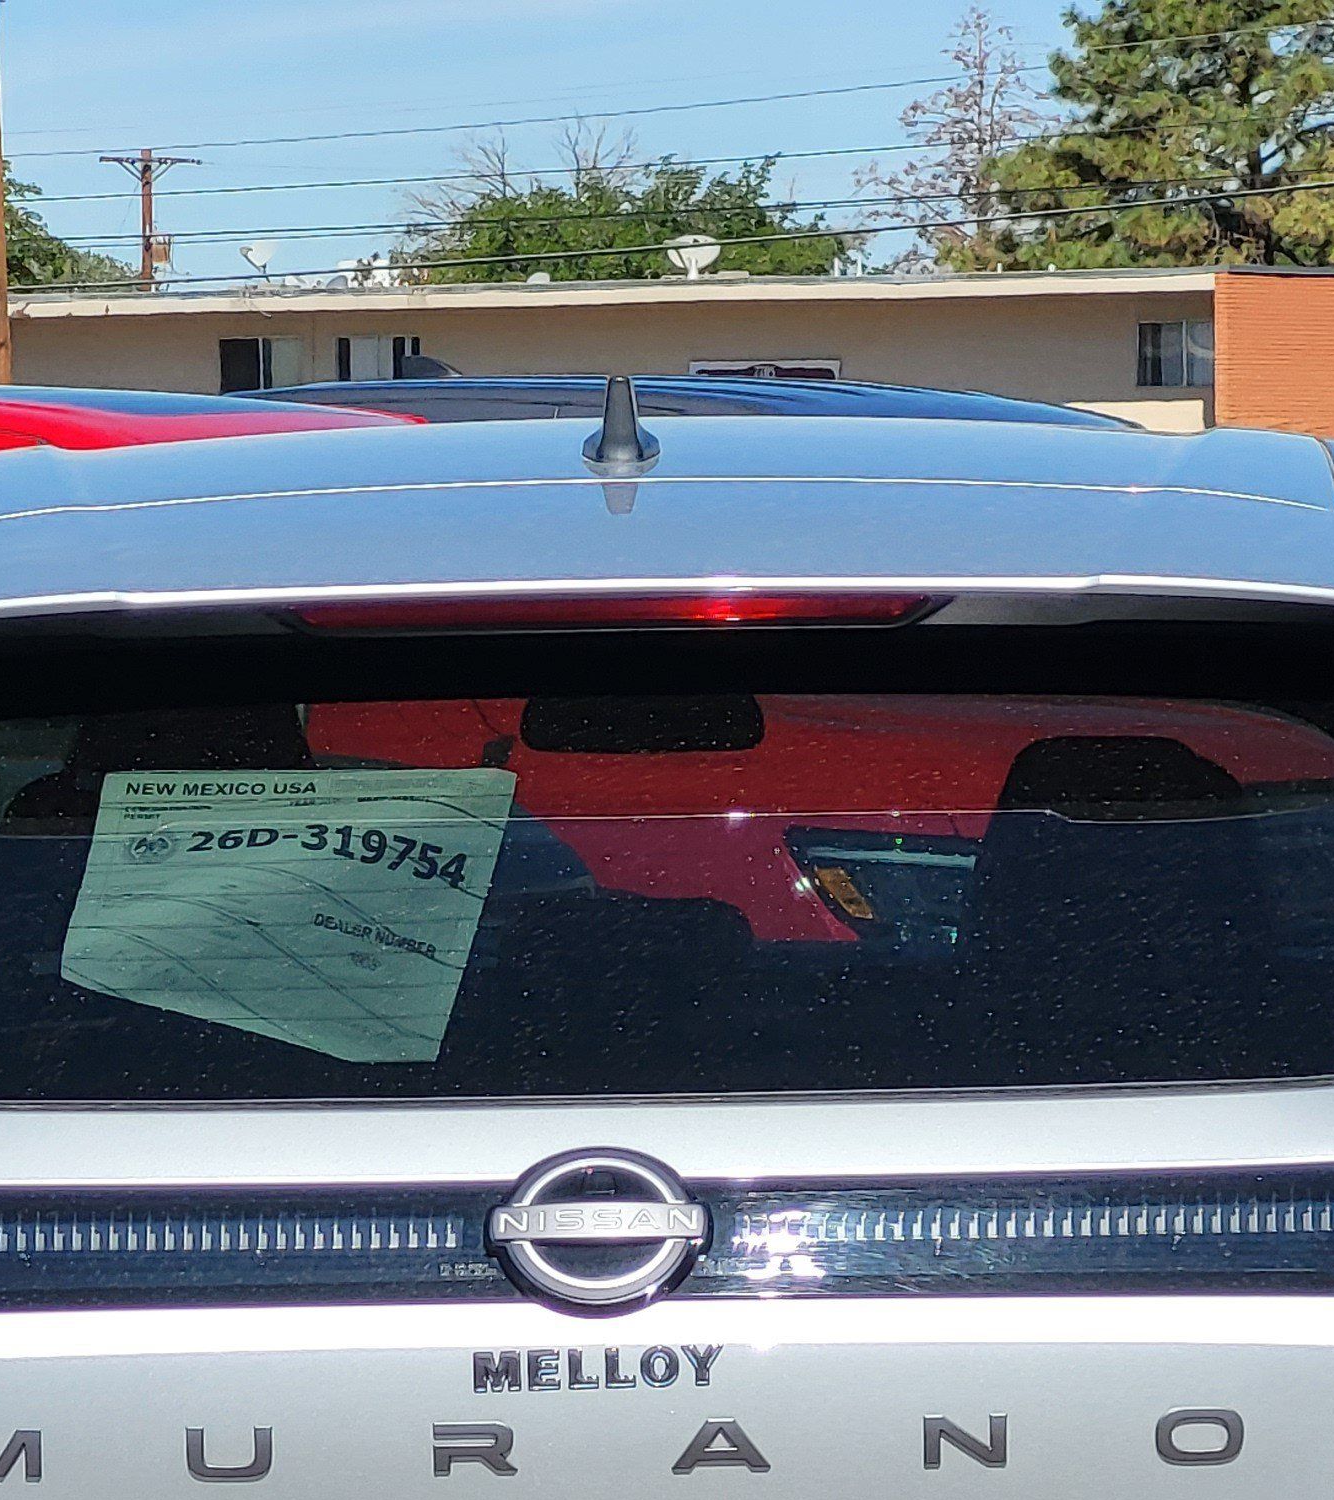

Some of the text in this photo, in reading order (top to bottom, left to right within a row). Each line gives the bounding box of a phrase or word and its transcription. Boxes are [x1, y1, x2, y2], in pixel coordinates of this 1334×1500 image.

[125, 781, 317, 796] NEW MEXICO USA
[186, 824, 468, 888] 26D-319754
[313, 913, 437, 958] DEALER NUMBER
[497, 1207, 699, 1233] NISSAN
[472, 1345, 724, 1394] MELLOY
